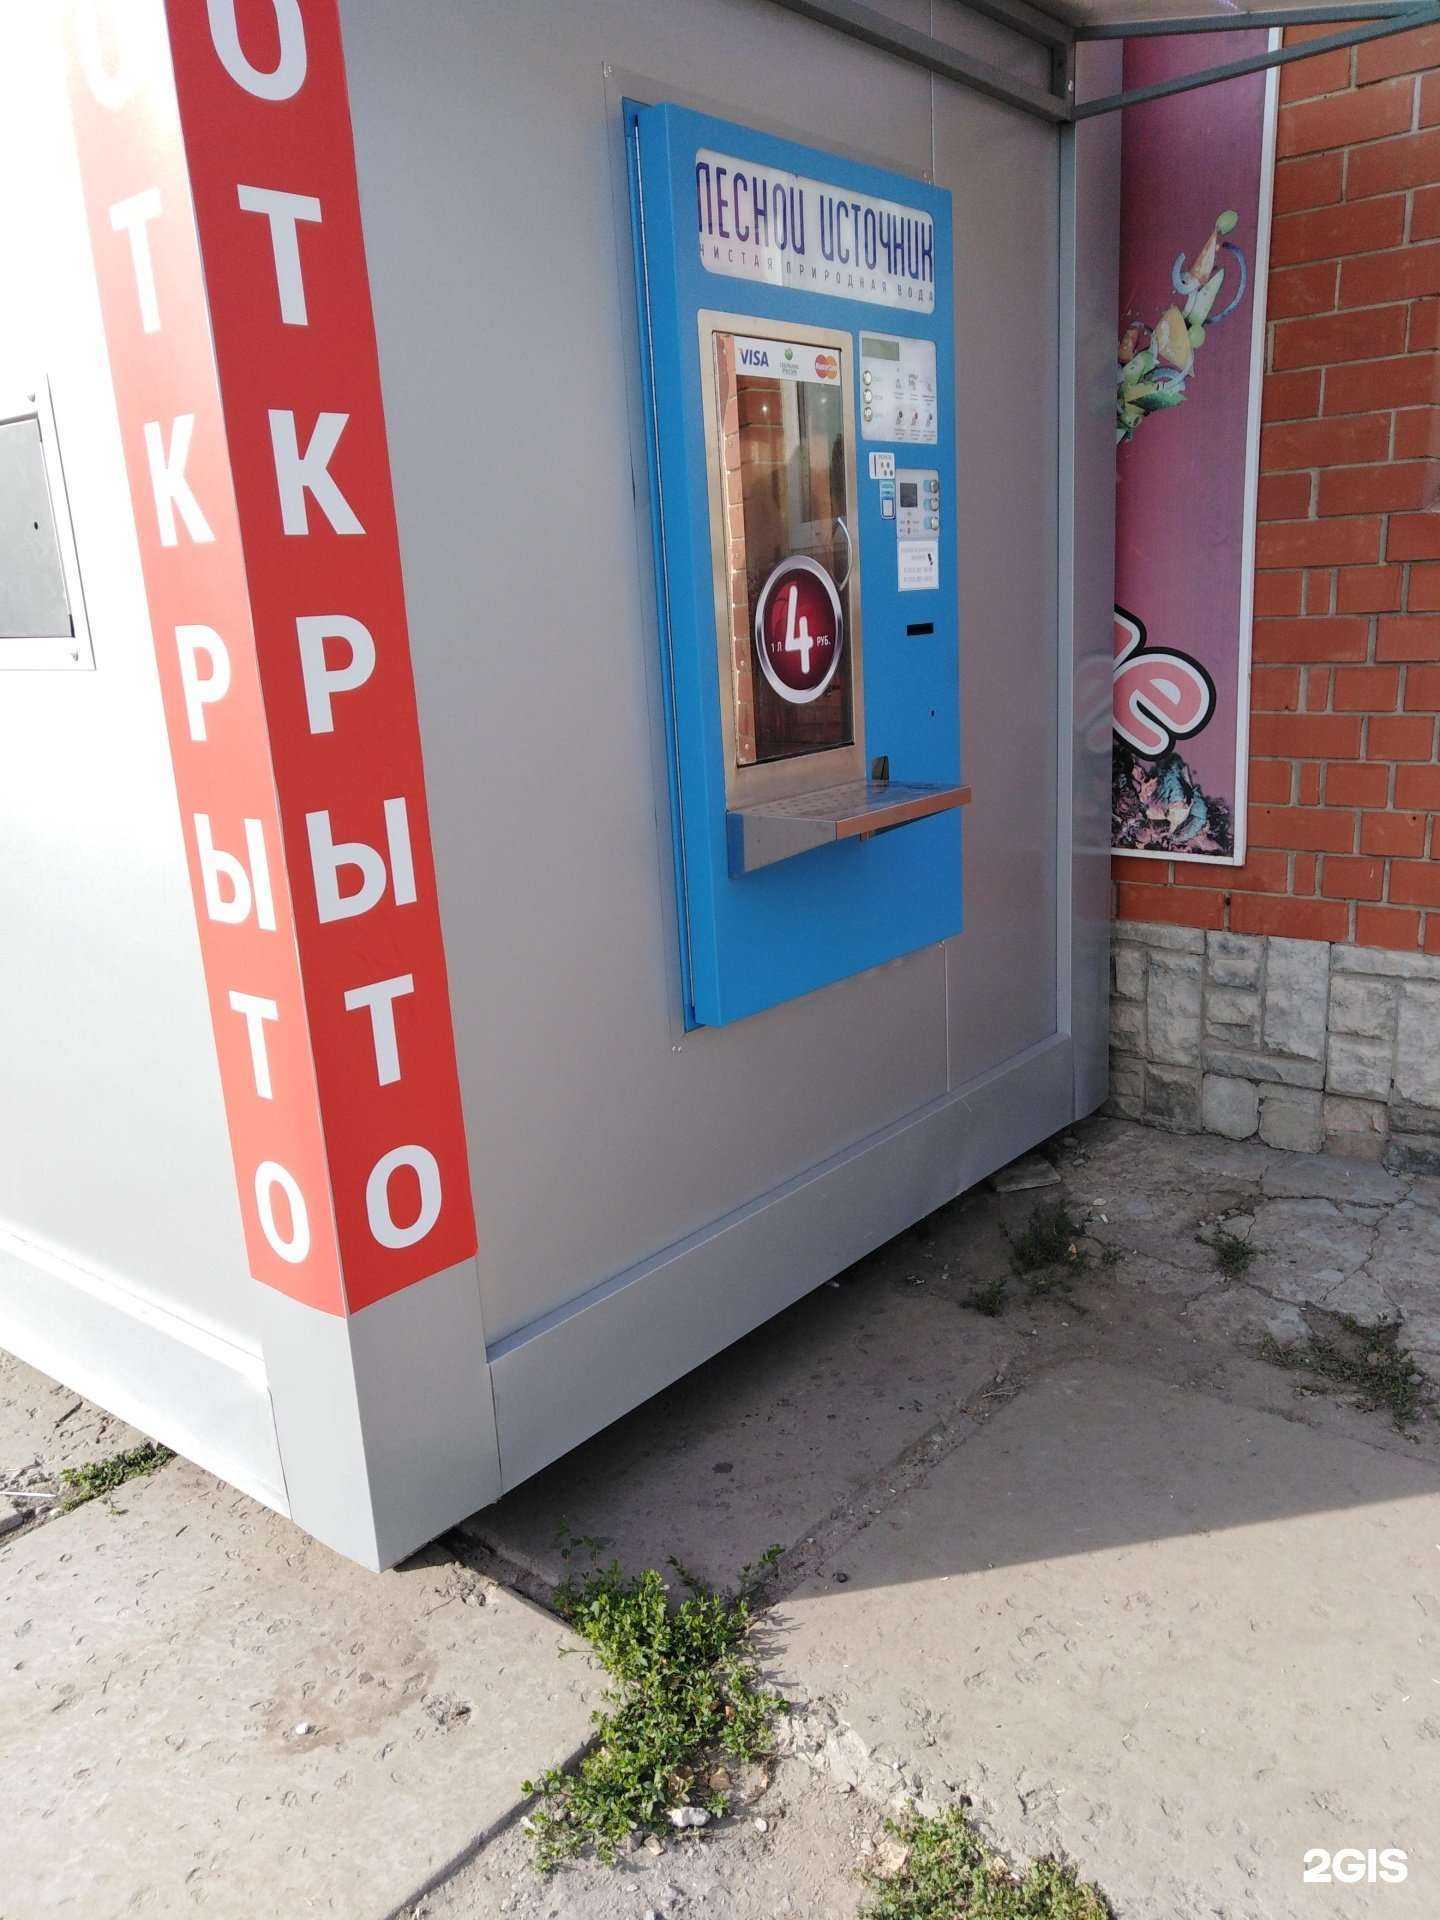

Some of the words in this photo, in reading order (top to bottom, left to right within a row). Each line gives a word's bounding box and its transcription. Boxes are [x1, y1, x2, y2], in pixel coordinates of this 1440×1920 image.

[786, 261, 887, 291] ПРИРОДНАЯ
[819, 194, 933, 283] ИСТОЧНИК
[741, 348, 769, 368] VISA
[75, 0, 310, 1263] ОТКРЫТО
[207, 0, 443, 1249] ОТКРЫТО
[785, 585, 814, 674] 4
